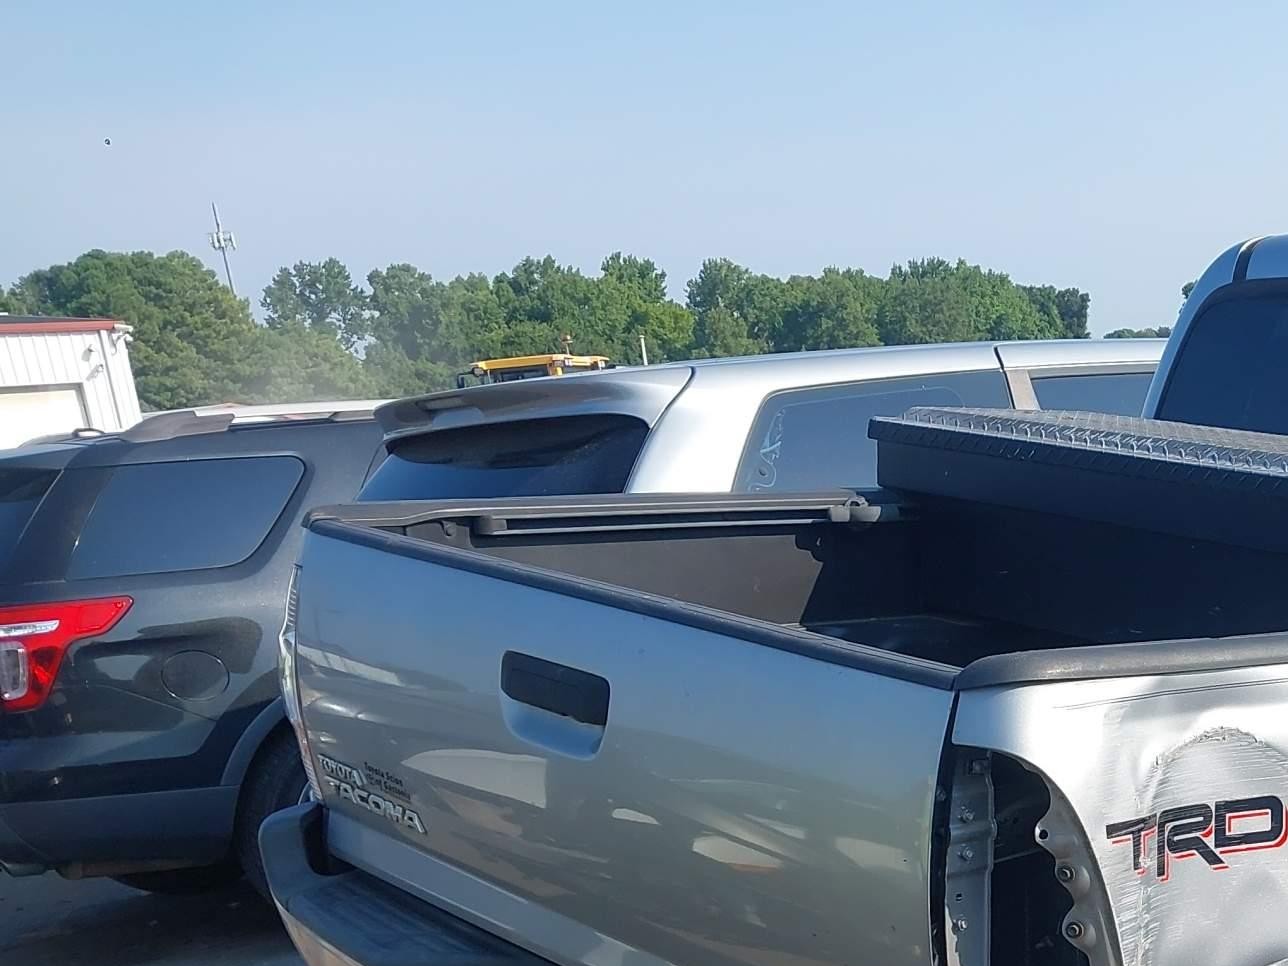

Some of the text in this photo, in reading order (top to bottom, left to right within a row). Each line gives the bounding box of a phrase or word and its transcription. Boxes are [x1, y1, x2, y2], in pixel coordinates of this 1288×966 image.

[317, 754, 366, 786] TOYOTA
[323, 775, 427, 835] TACOMA
[1106, 795, 1288, 882] TRD
